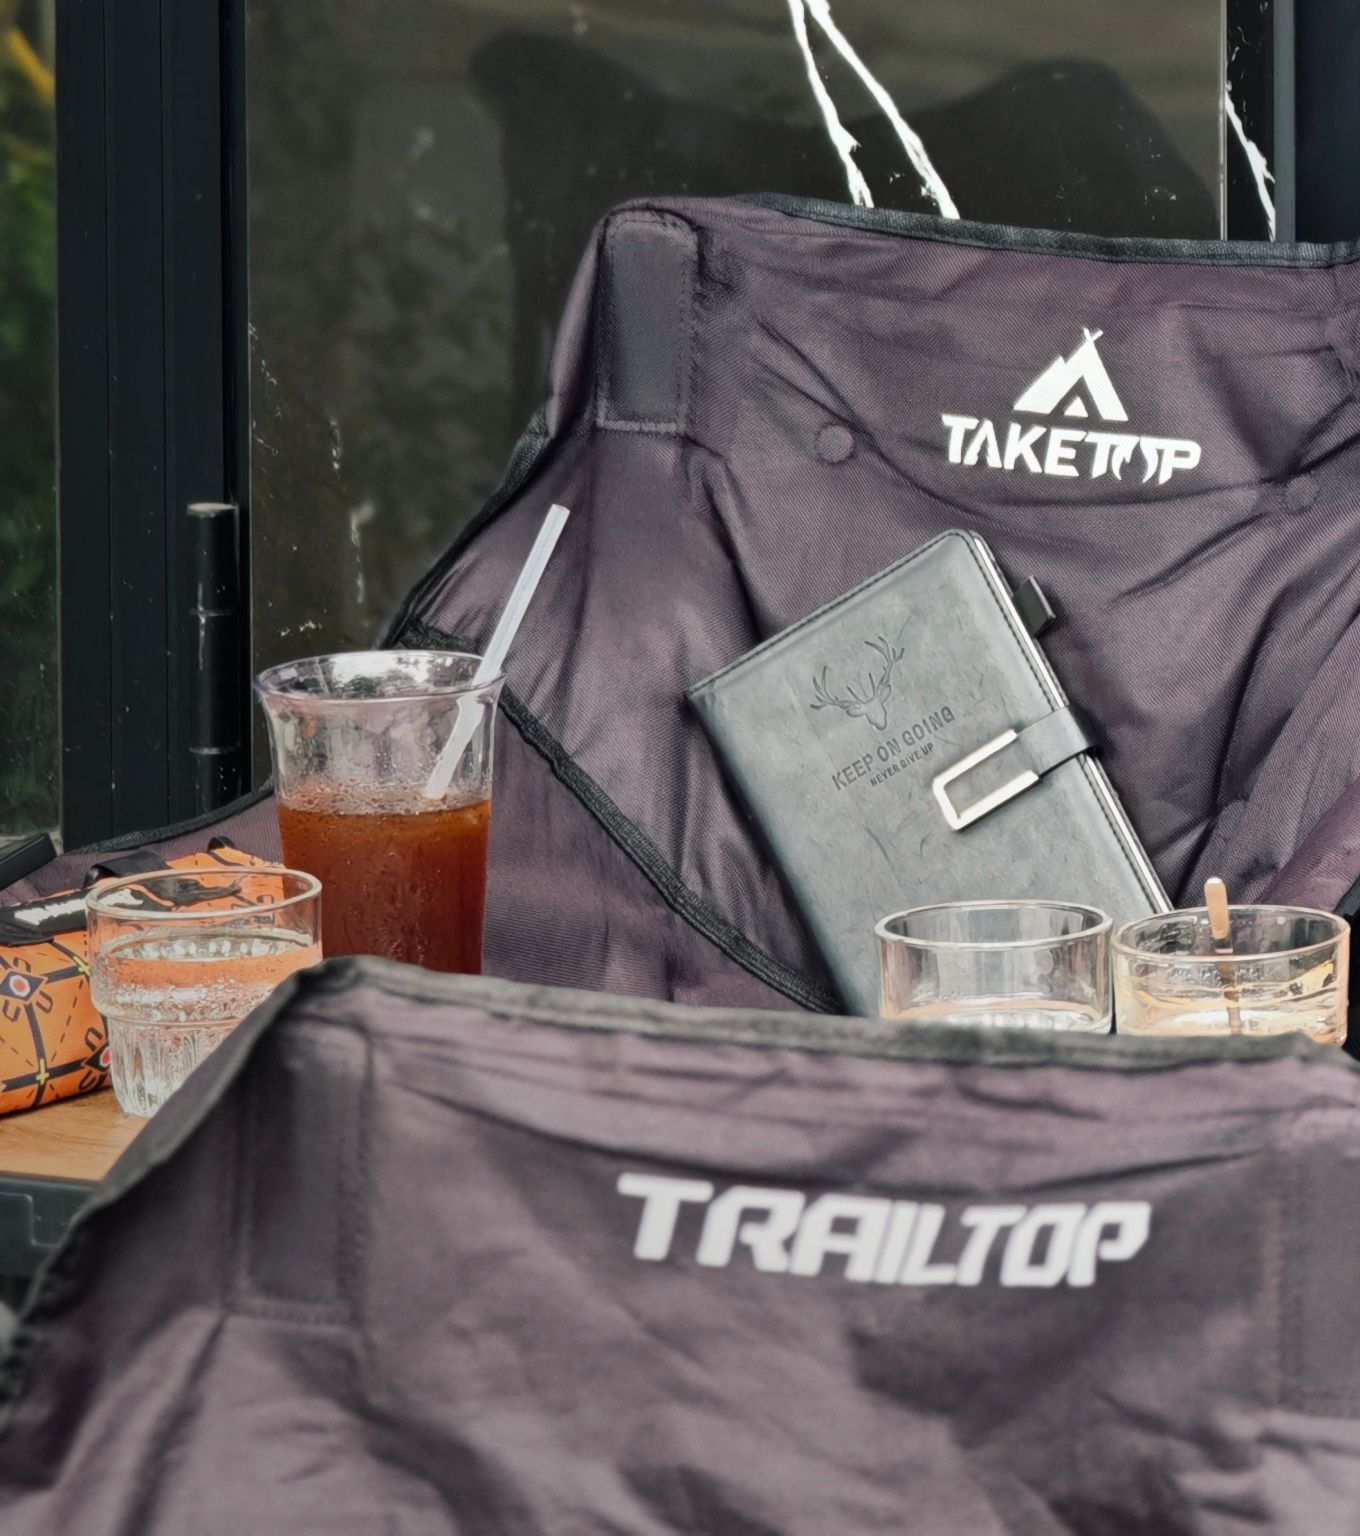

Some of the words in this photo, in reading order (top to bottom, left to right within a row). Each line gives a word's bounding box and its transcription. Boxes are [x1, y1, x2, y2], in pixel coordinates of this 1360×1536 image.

[941, 413, 1202, 485] TAKETOP
[831, 753, 874, 791] KEEP
[876, 737, 902, 762] ON
[902, 706, 956, 746] GOING
[870, 765, 901, 787] NEVER
[921, 742, 934, 756] UP
[617, 1172, 1152, 1287] TRAILTOP
